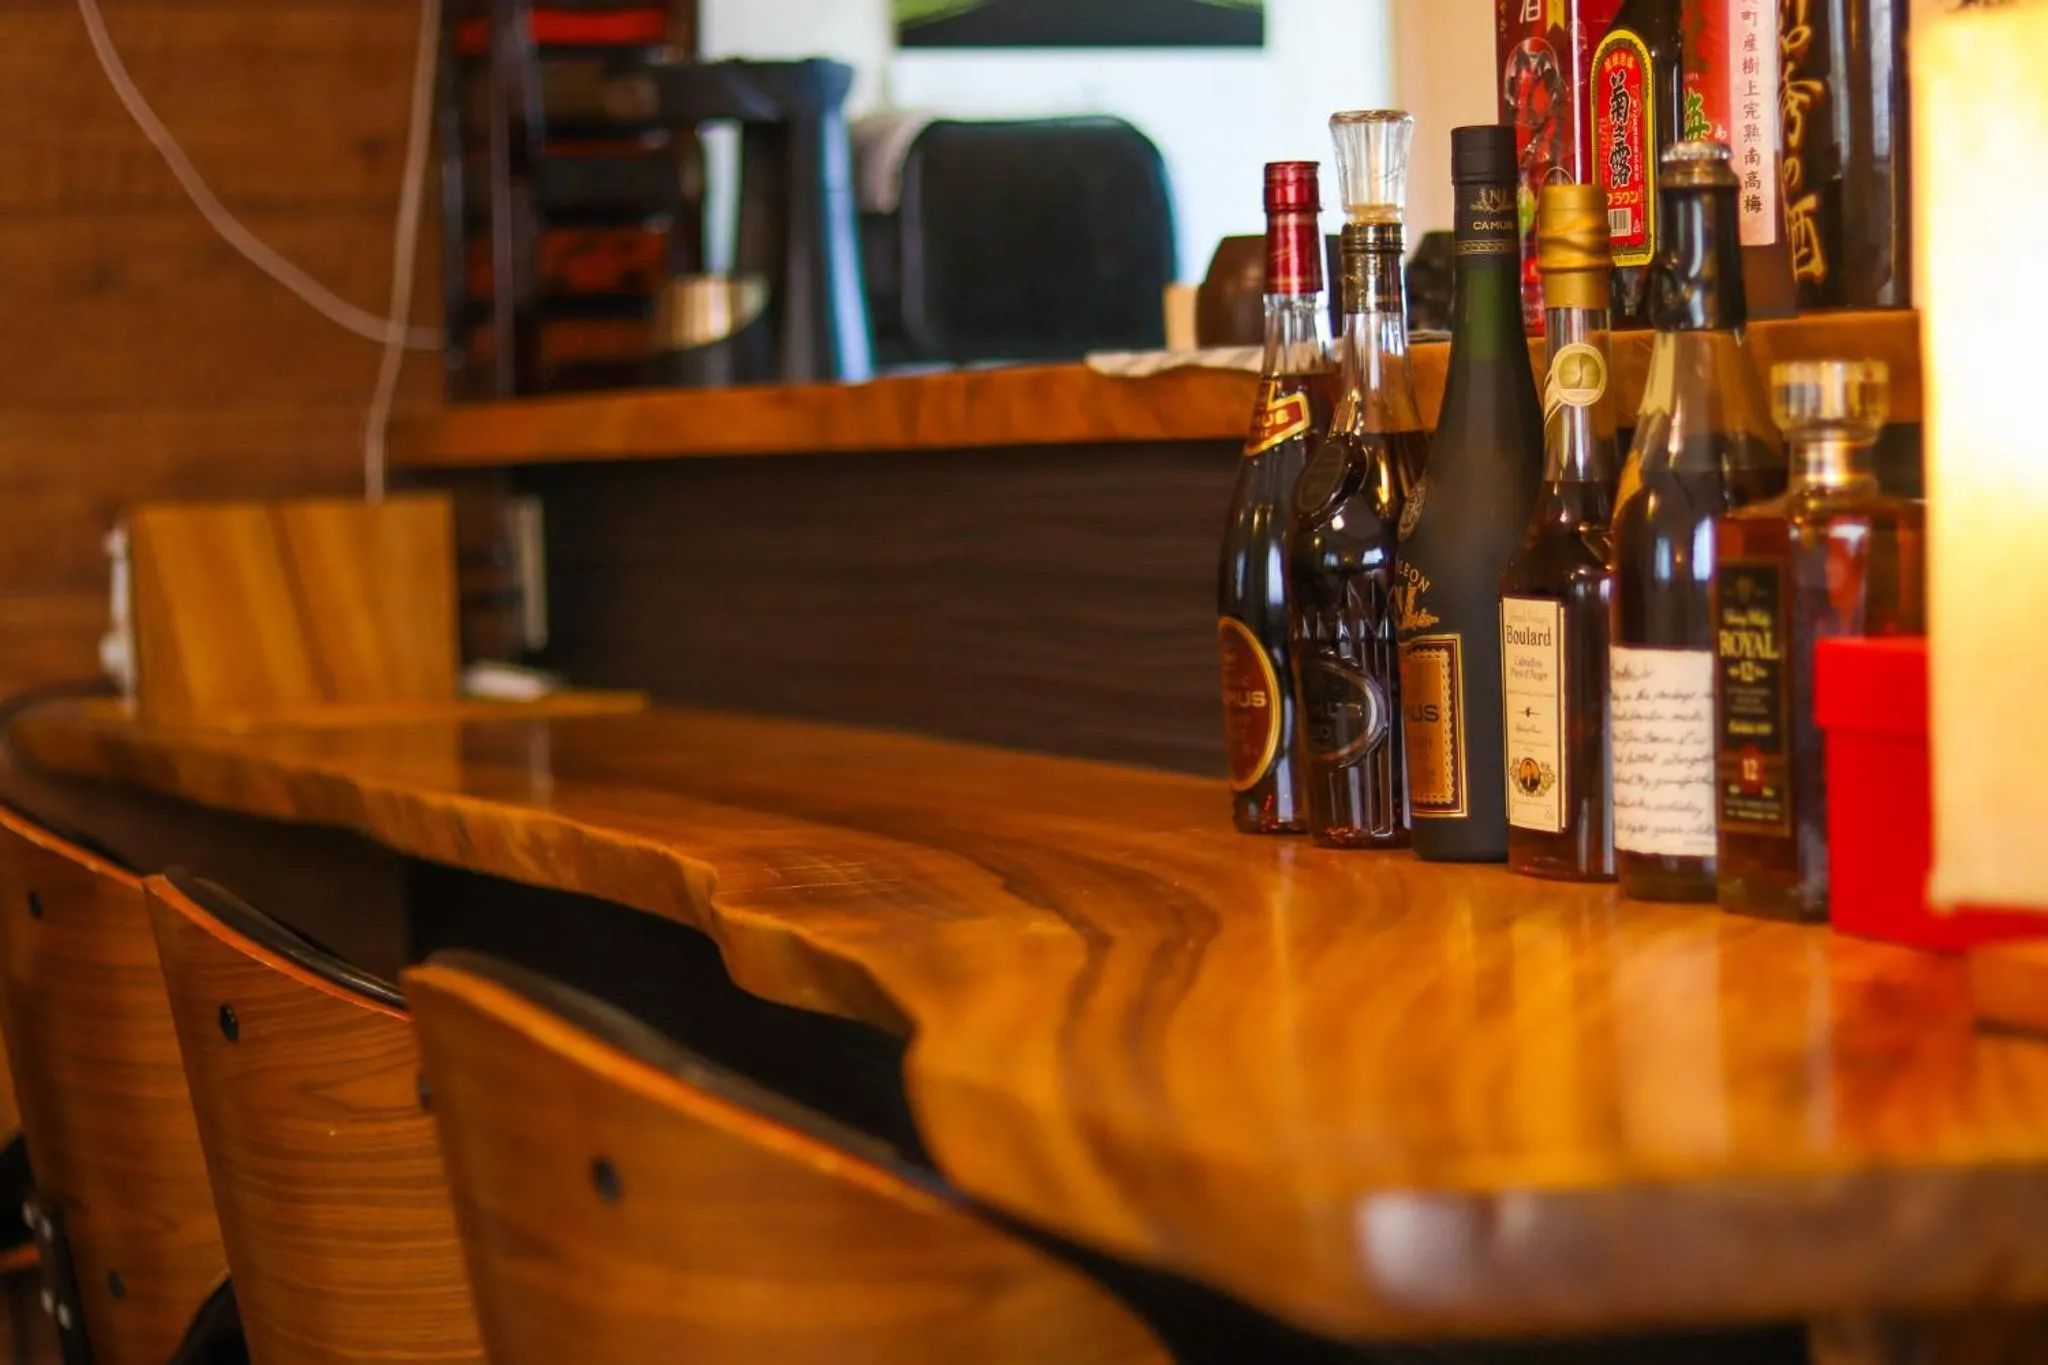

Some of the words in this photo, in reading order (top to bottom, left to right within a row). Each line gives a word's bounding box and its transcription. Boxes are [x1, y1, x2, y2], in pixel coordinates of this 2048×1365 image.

[1740, 0, 1763, 214] 町産樹上完熟南高梅
[1506, 624, 1551, 647] Boulard
